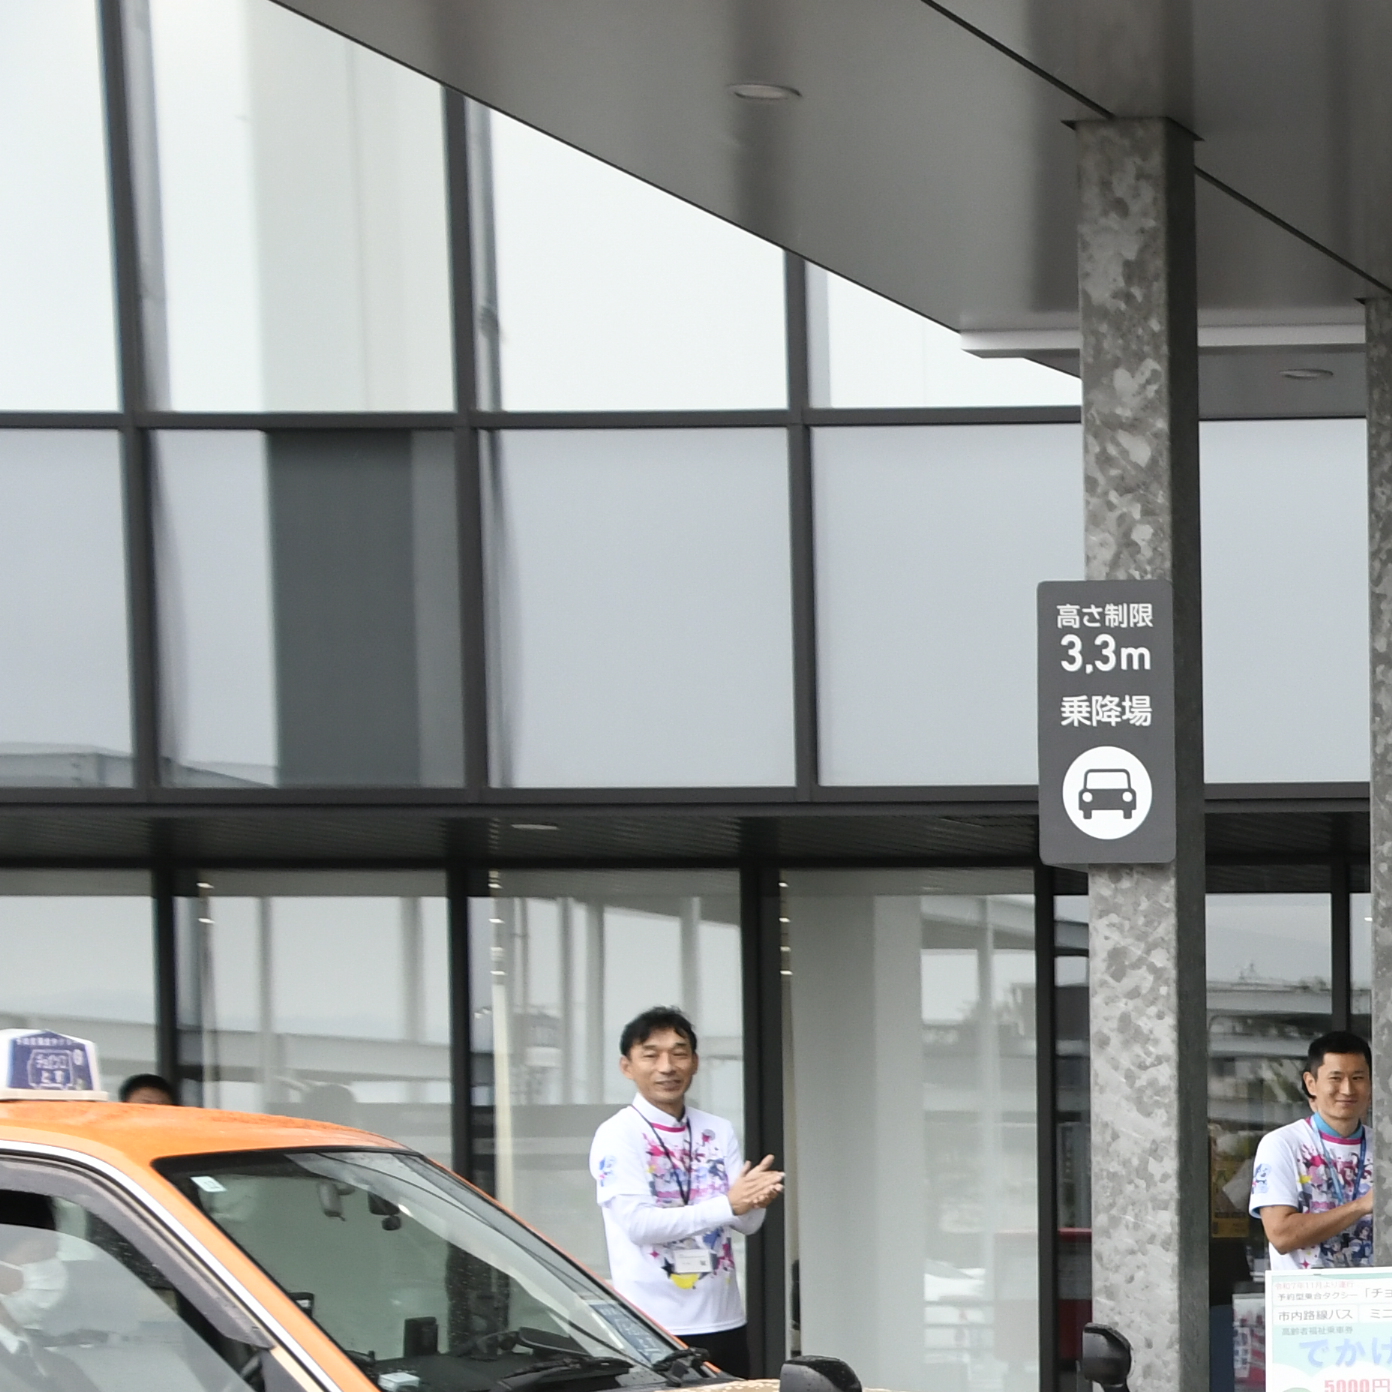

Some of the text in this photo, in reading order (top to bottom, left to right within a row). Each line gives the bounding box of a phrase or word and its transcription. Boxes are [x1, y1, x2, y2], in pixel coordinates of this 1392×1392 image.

[1056, 603, 1153, 629] 高さ制限
[1060, 695, 1153, 727] 乗降場
[1278, 1291, 1358, 1302] 予約型乗合タクシー
[1278, 1309, 1353, 1321] 市内路線バス
